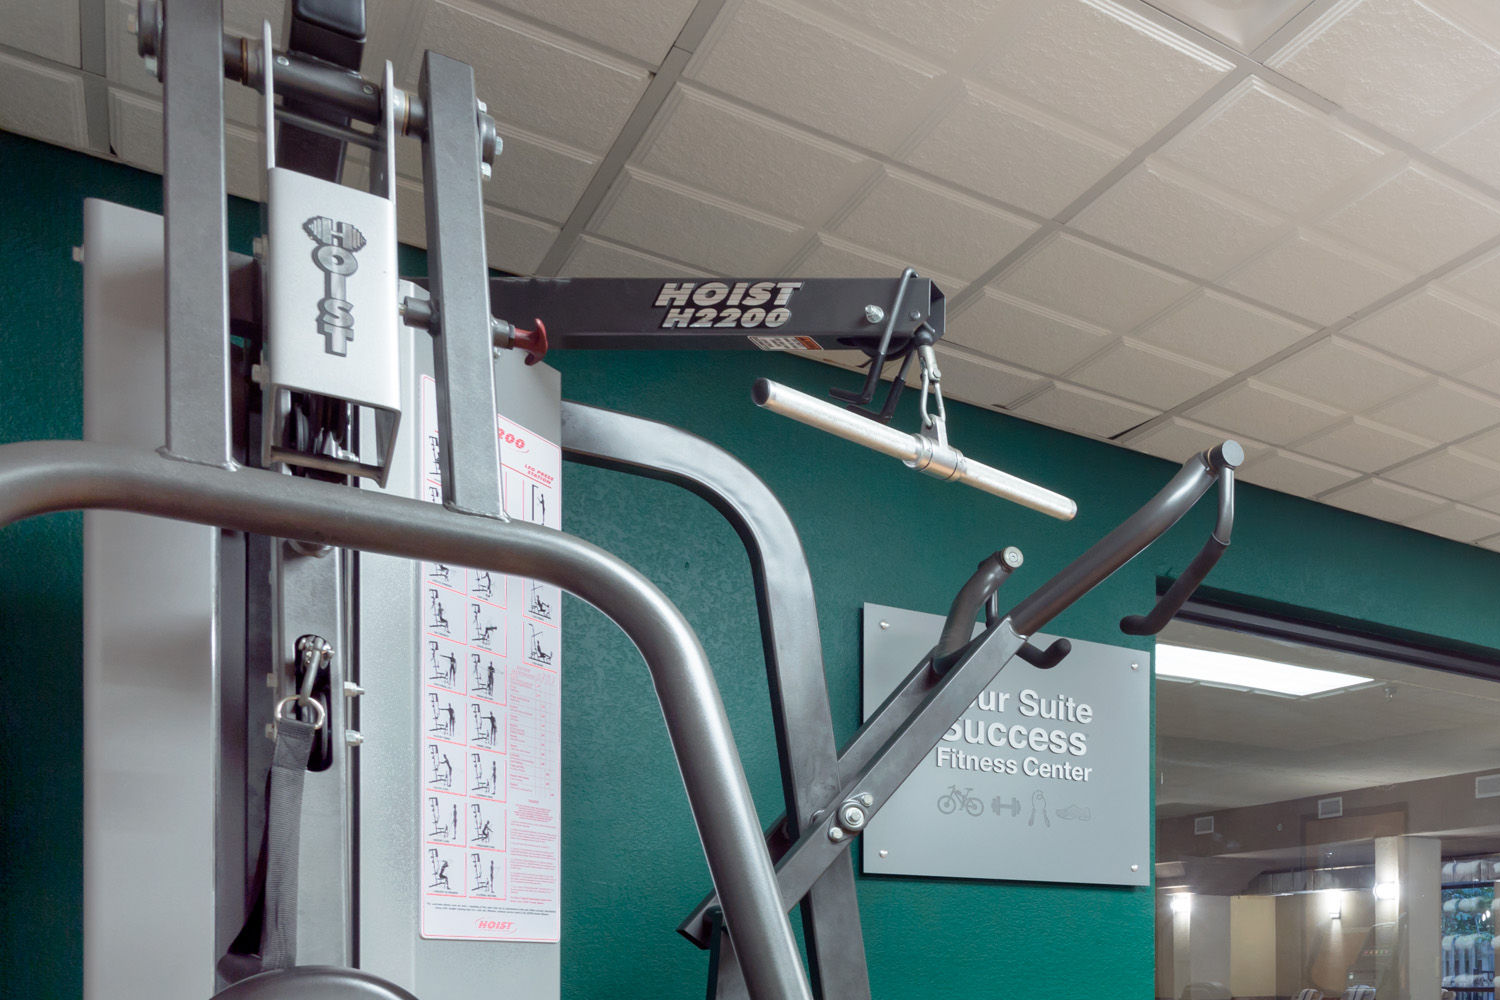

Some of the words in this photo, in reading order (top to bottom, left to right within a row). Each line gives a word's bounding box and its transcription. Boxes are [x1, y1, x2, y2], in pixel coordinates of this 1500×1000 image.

[302, 216, 367, 358] HOIST
[652, 281, 804, 307] HOIST
[660, 307, 792, 329] H2200
[498, 427, 525, 449] 200
[1018, 688, 1093, 724] Suite
[935, 745, 1019, 776] Fitness
[1022, 755, 1093, 783] Center
[478, 920, 515, 930] HOIST
